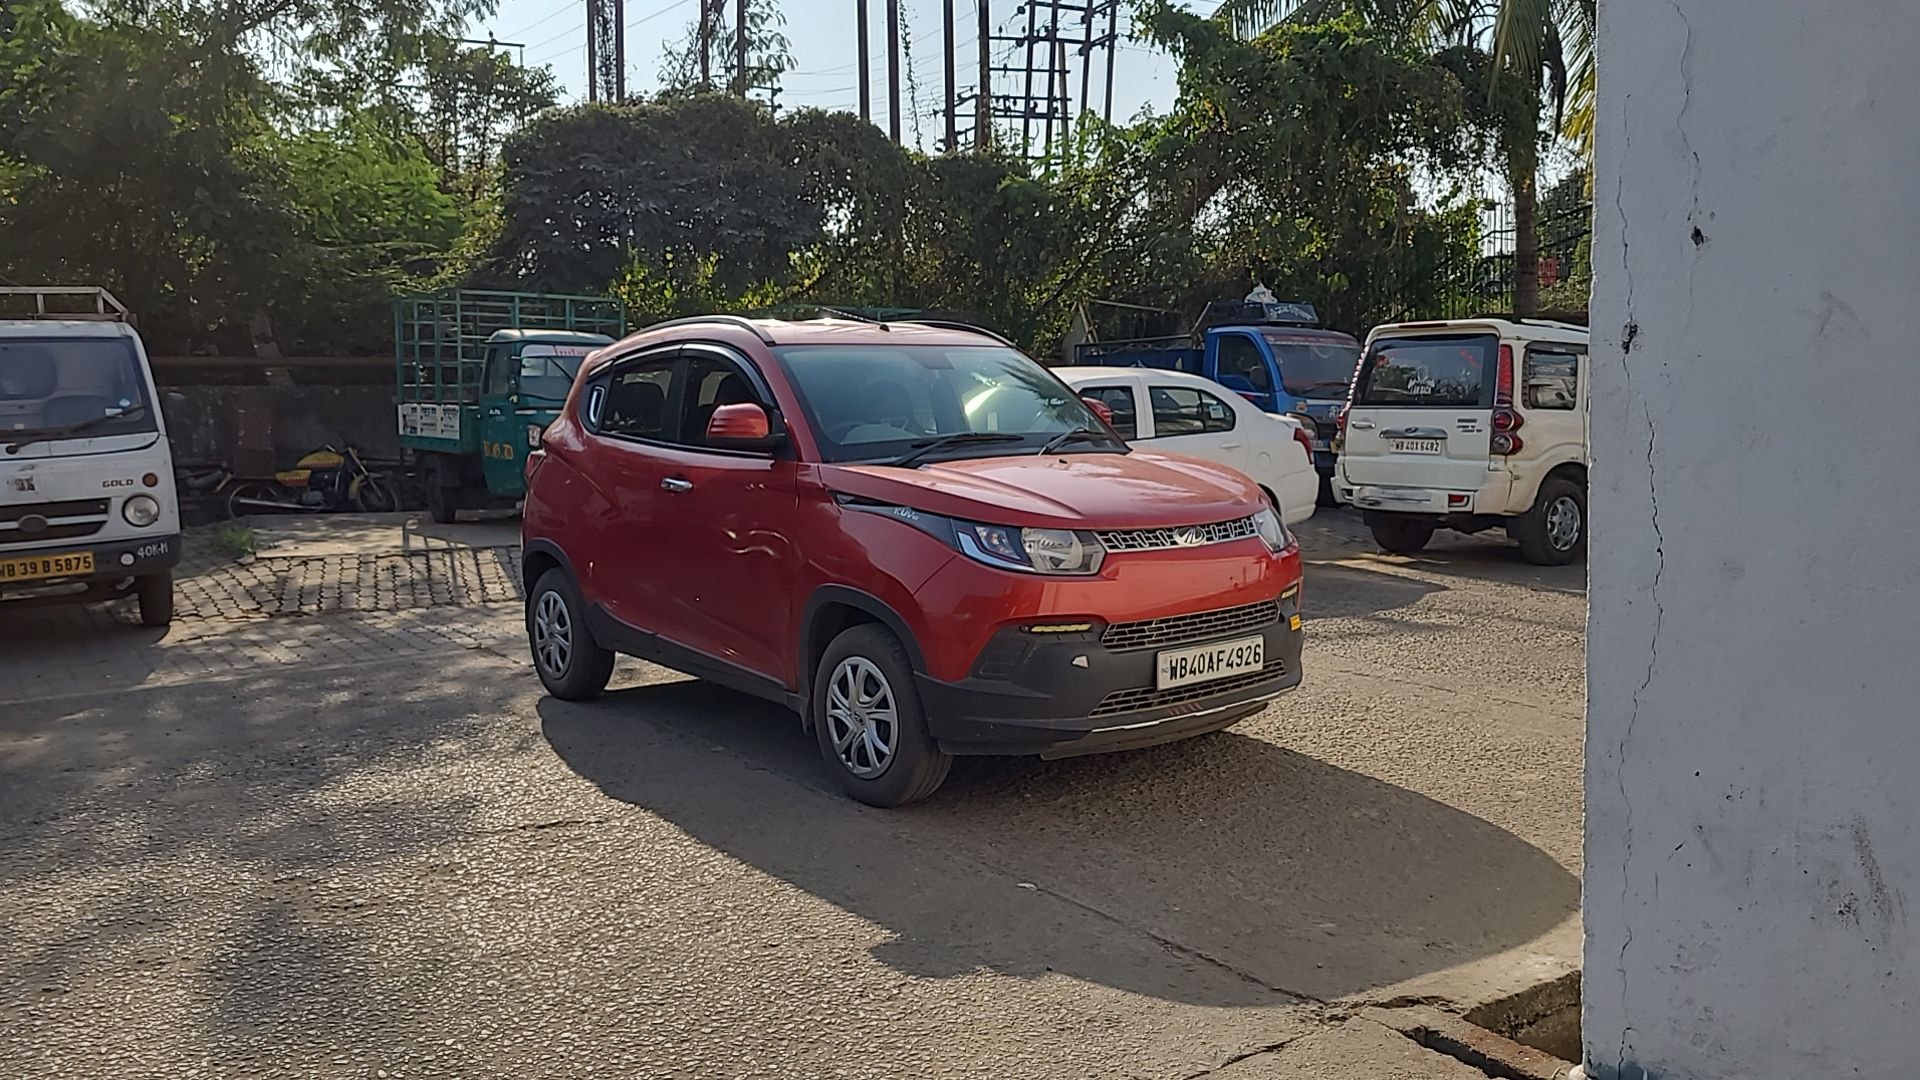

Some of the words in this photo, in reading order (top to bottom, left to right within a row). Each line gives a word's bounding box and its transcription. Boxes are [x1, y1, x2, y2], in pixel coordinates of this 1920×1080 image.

[102, 478, 134, 488] GOLD
[19, 562, 38, 576] 39
[55, 556, 92, 572] 5875
[1169, 643, 1261, 681] WB40AF4926
